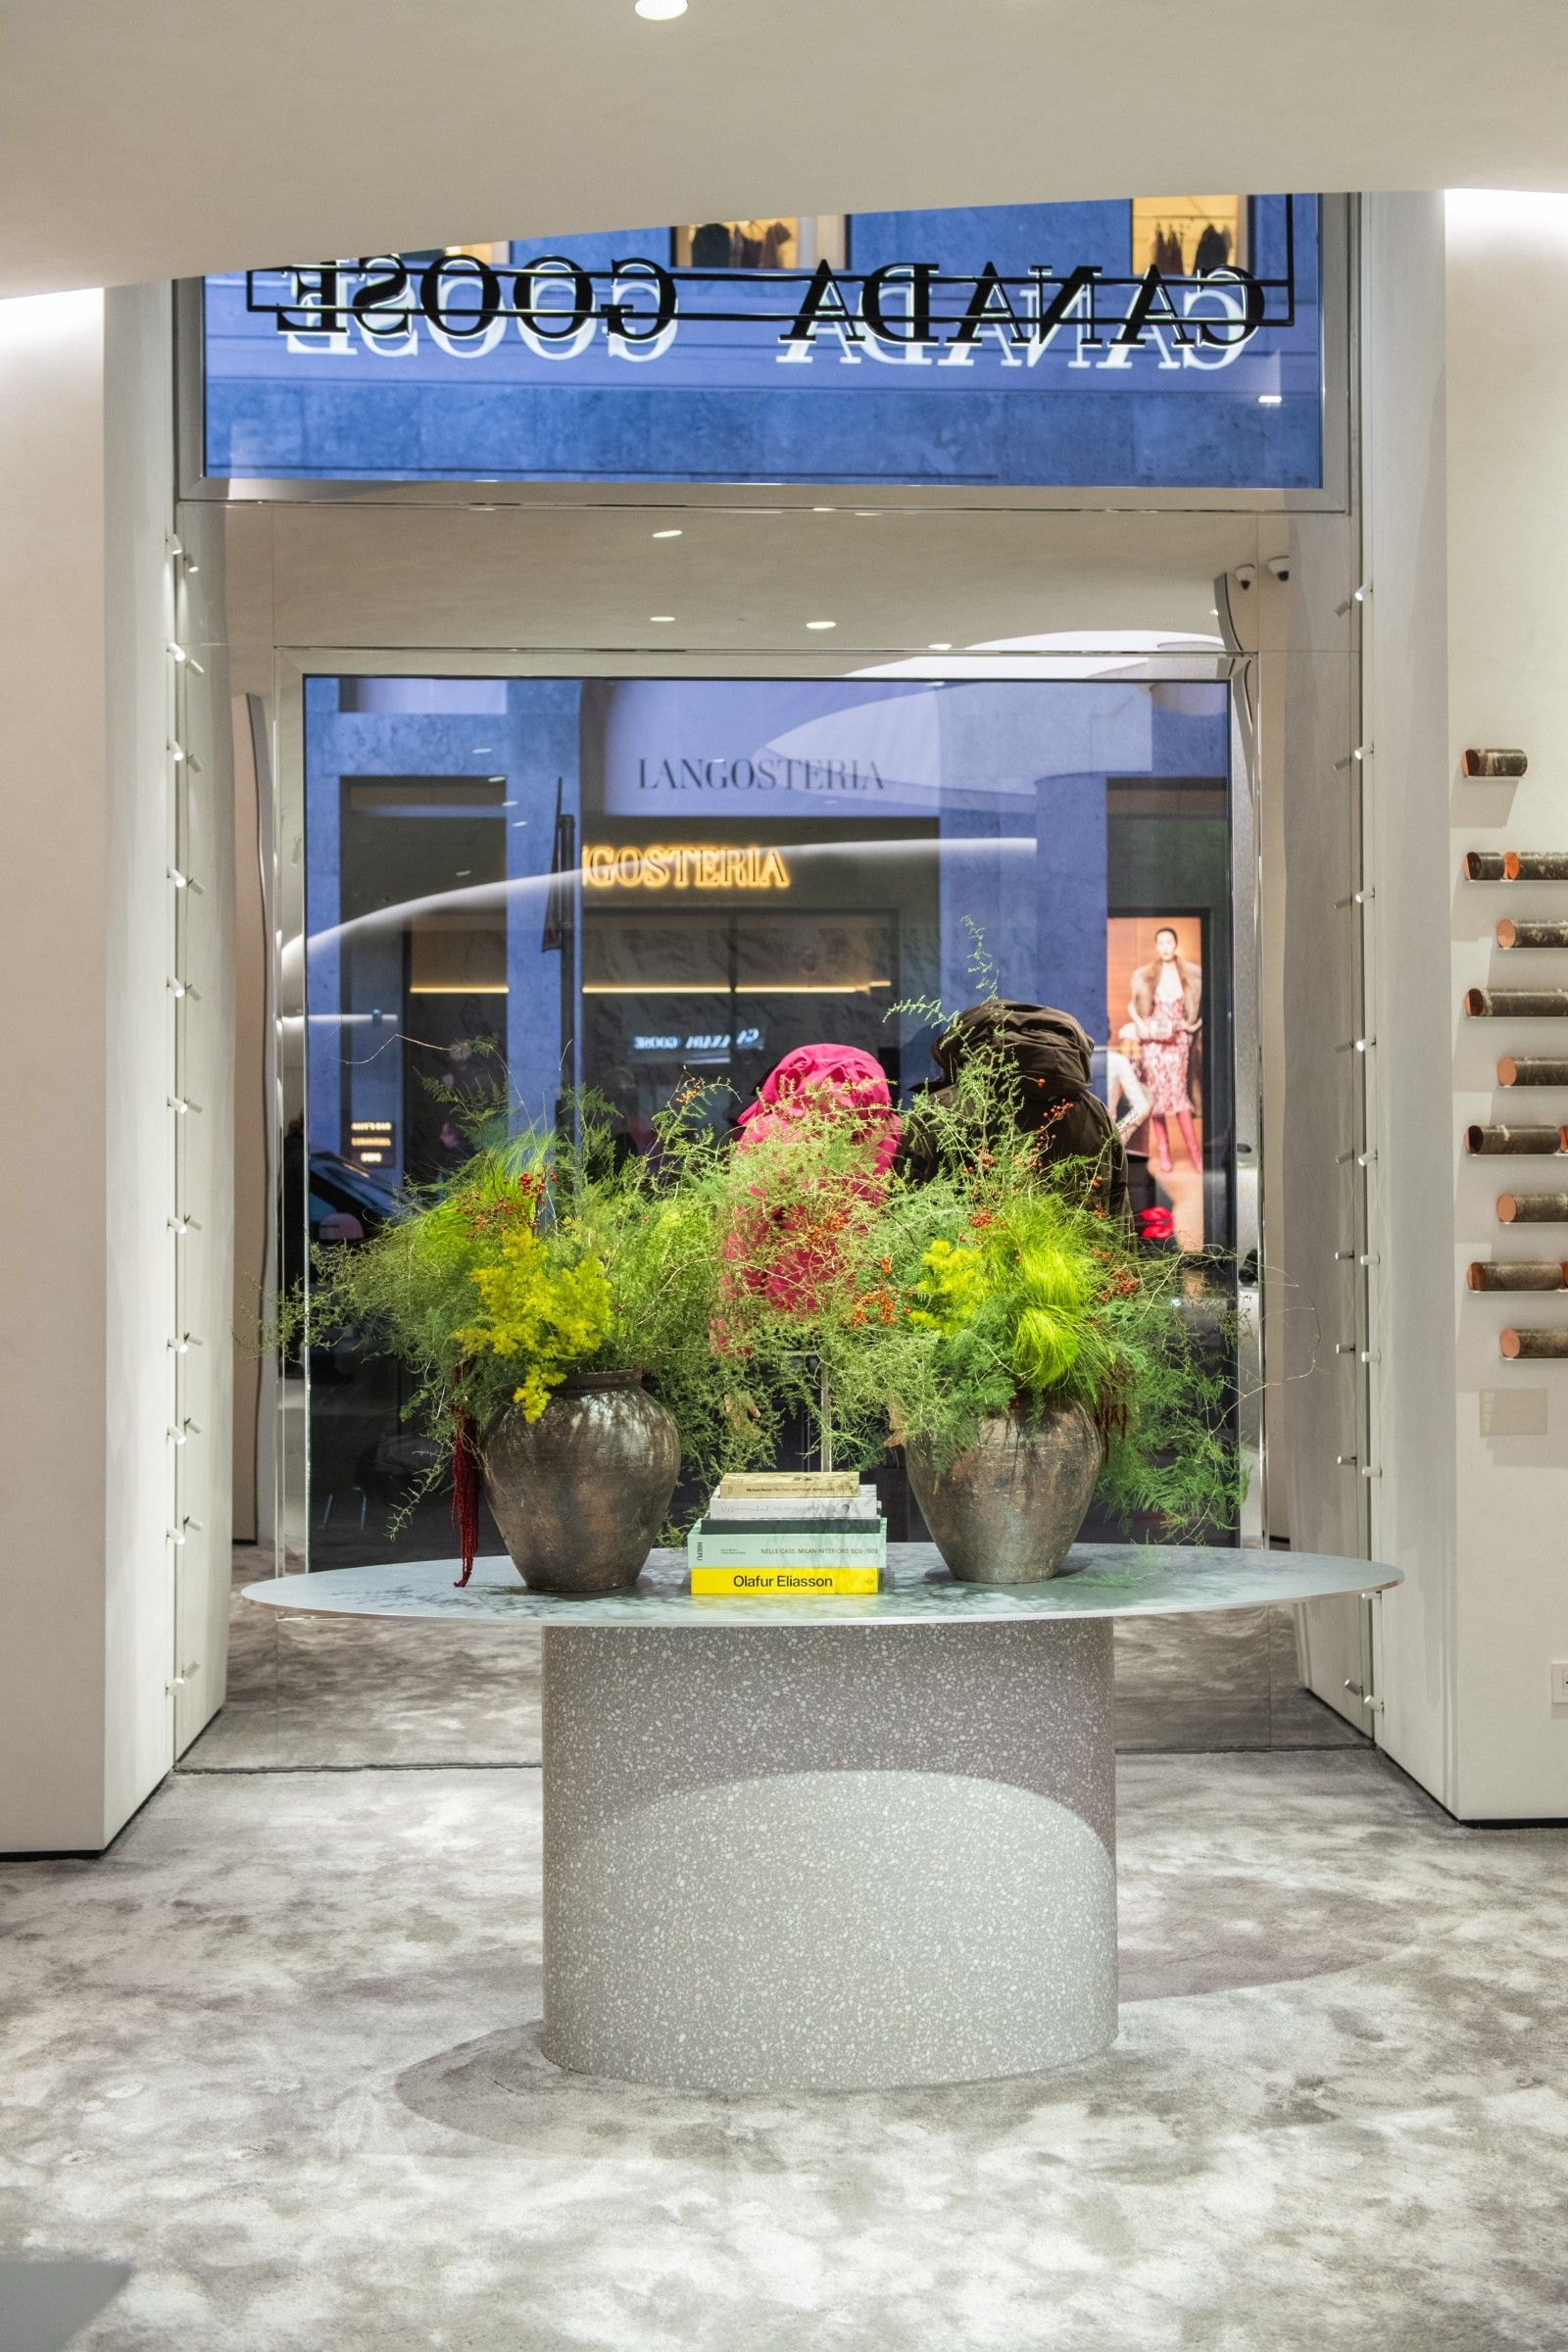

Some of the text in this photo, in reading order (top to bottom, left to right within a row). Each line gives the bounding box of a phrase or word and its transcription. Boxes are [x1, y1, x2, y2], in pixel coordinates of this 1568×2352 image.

[638, 758, 886, 791] LANGOSTERIA
[733, 1575, 833, 1588] Olafur Eliasson
